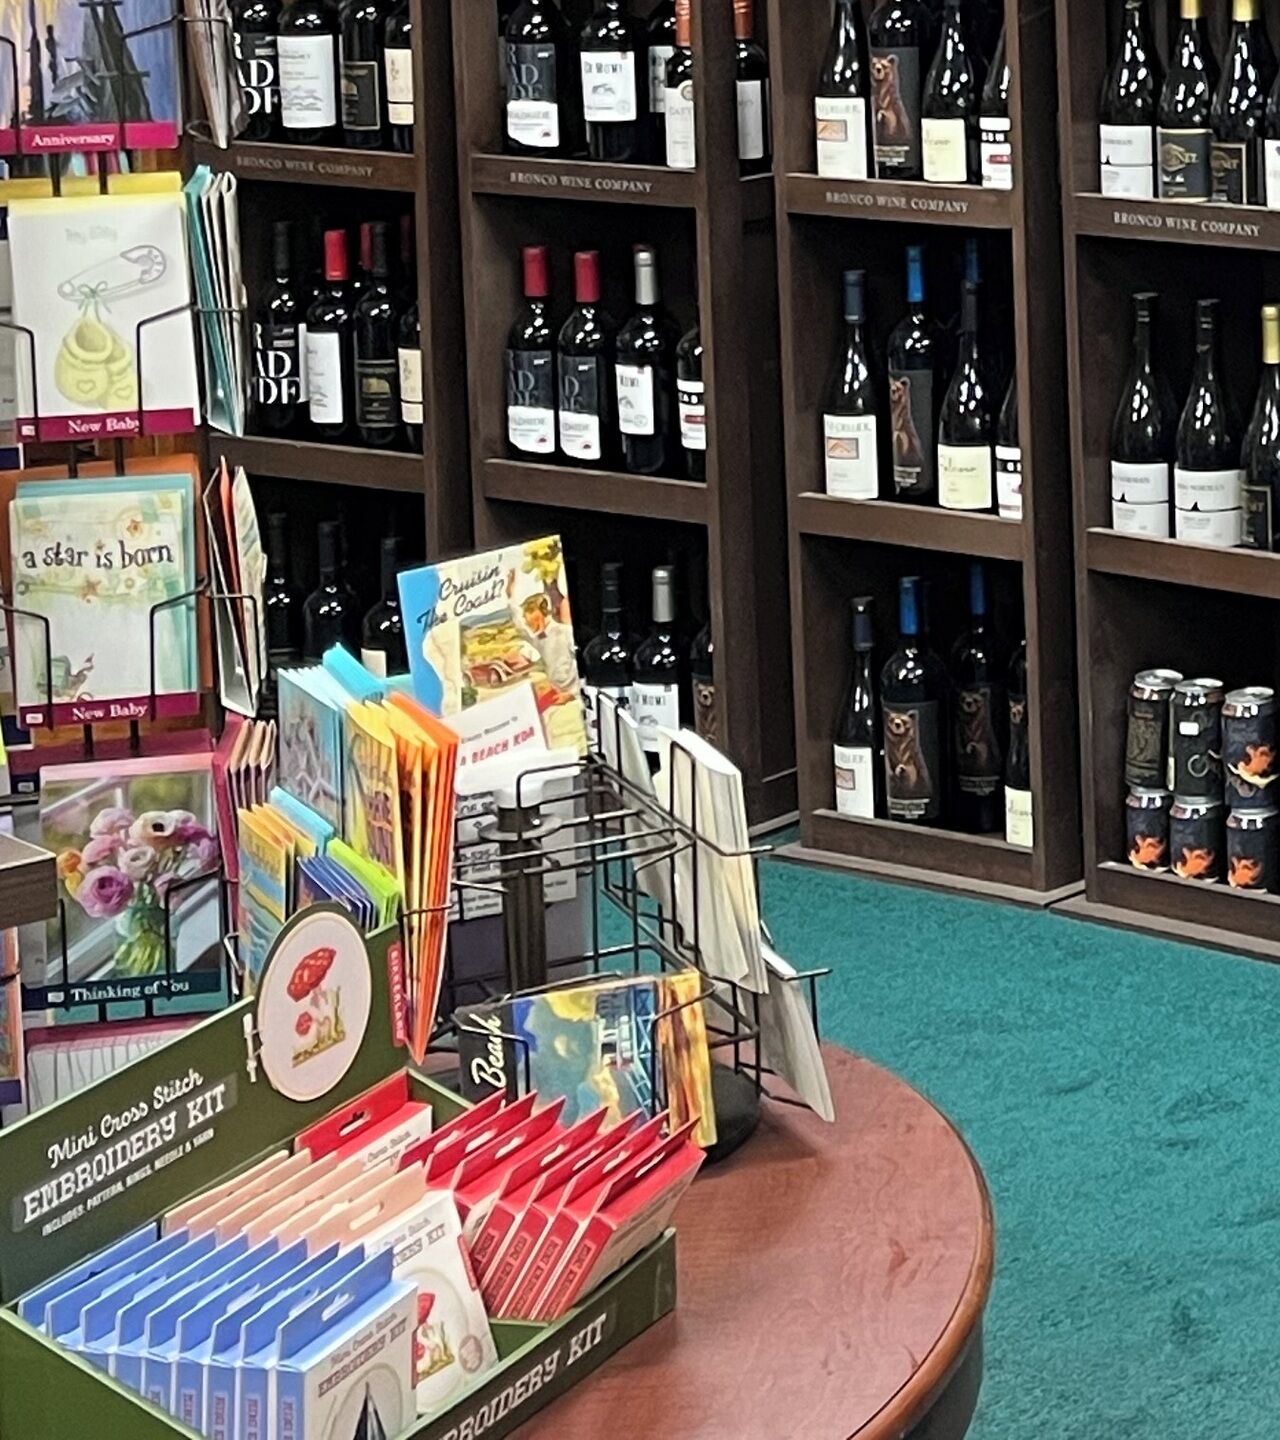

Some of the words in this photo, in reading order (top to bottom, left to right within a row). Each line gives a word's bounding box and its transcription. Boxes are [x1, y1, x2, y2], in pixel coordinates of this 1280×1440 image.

[31, 131, 115, 148] Anniversary
[825, 191, 874, 206] BRONCO
[876, 195, 908, 209] WINE
[910, 197, 969, 214] COMPANY
[1113, 211, 1163, 228] BRONCO
[1165, 216, 1198, 231] WINE
[1200, 220, 1261, 238] COMPANY
[67, 418, 101, 435] New
[22, 551, 37, 569] a
[42, 541, 89, 568] star
[96, 542, 113, 569] is
[118, 539, 174, 570] born
[416, 609, 448, 635] The
[71, 706, 106, 722] New
[109, 701, 149, 721] Baby
[472, 735, 509, 764] BEACH
[70, 985, 142, 1002] Thinking
[144, 981, 161, 995] of
[471, 1008, 505, 1089] Beach
[48, 1125, 98, 1169] Mini
[100, 1101, 149, 1139] Cross
[153, 1068, 204, 1109] Stitch
[23, 1111, 177, 1224] EMBROIDERY
[186, 1083, 226, 1129] KIT
[566, 1312, 607, 1366] KIT
